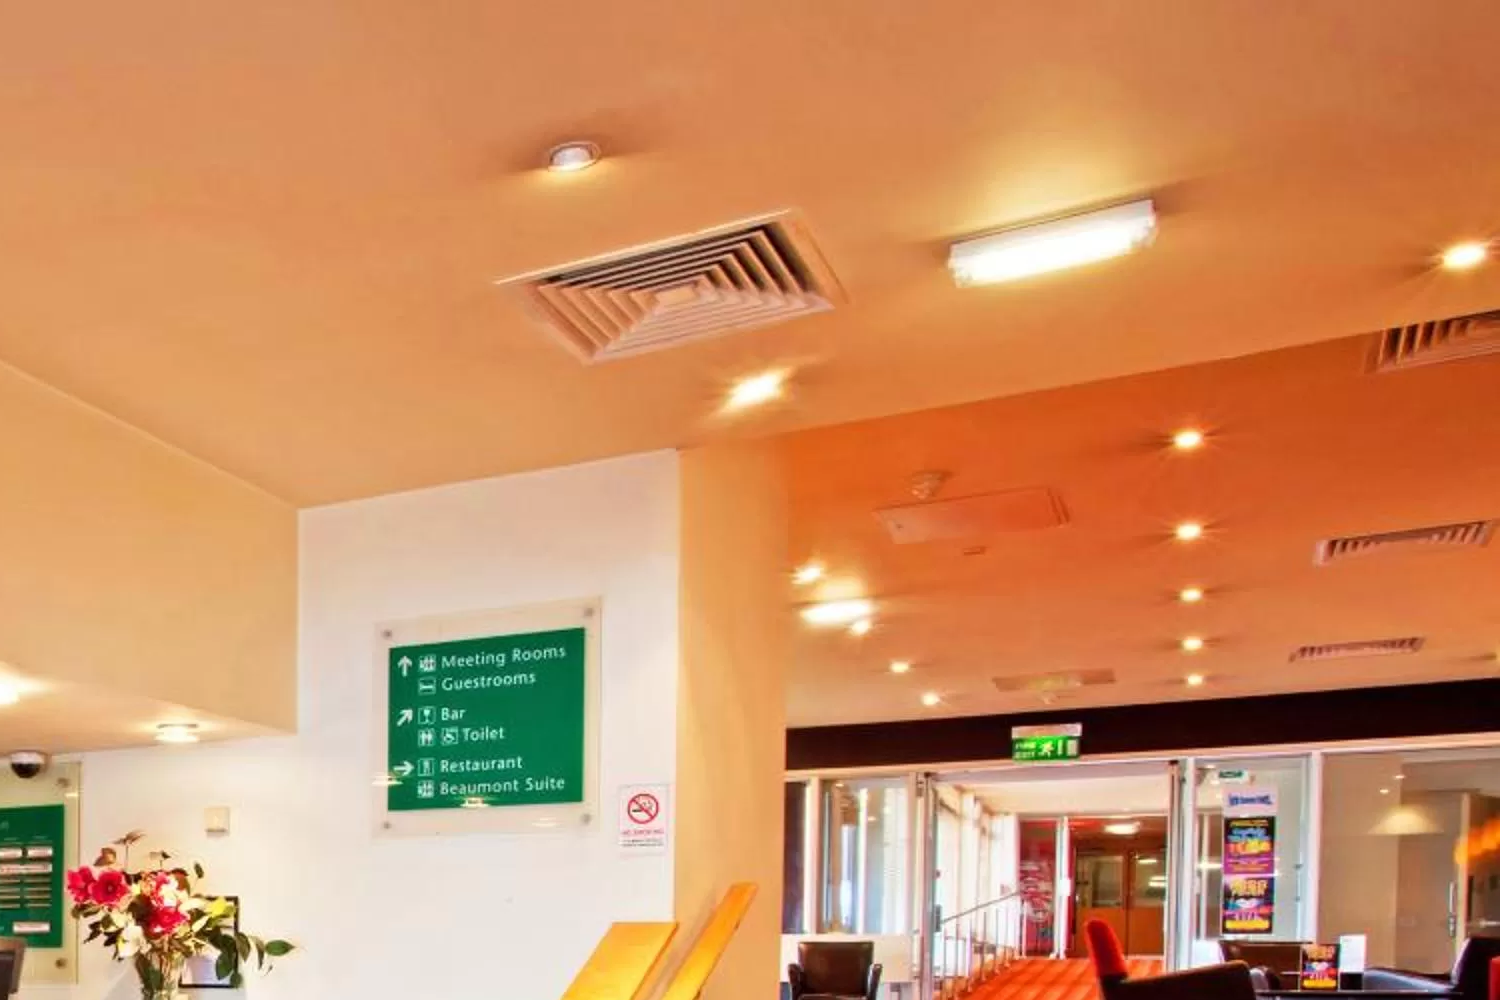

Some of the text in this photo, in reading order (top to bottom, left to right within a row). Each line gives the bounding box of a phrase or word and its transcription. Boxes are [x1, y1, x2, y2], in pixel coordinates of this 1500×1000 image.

[441, 647, 566, 668] Meeting Rooms
[441, 673, 536, 691] Guestrooms
[441, 707, 466, 721] Bar
[462, 725, 505, 741] Toilet
[440, 756, 523, 772] Restaurant
[440, 776, 566, 795] Beaumont Suite
